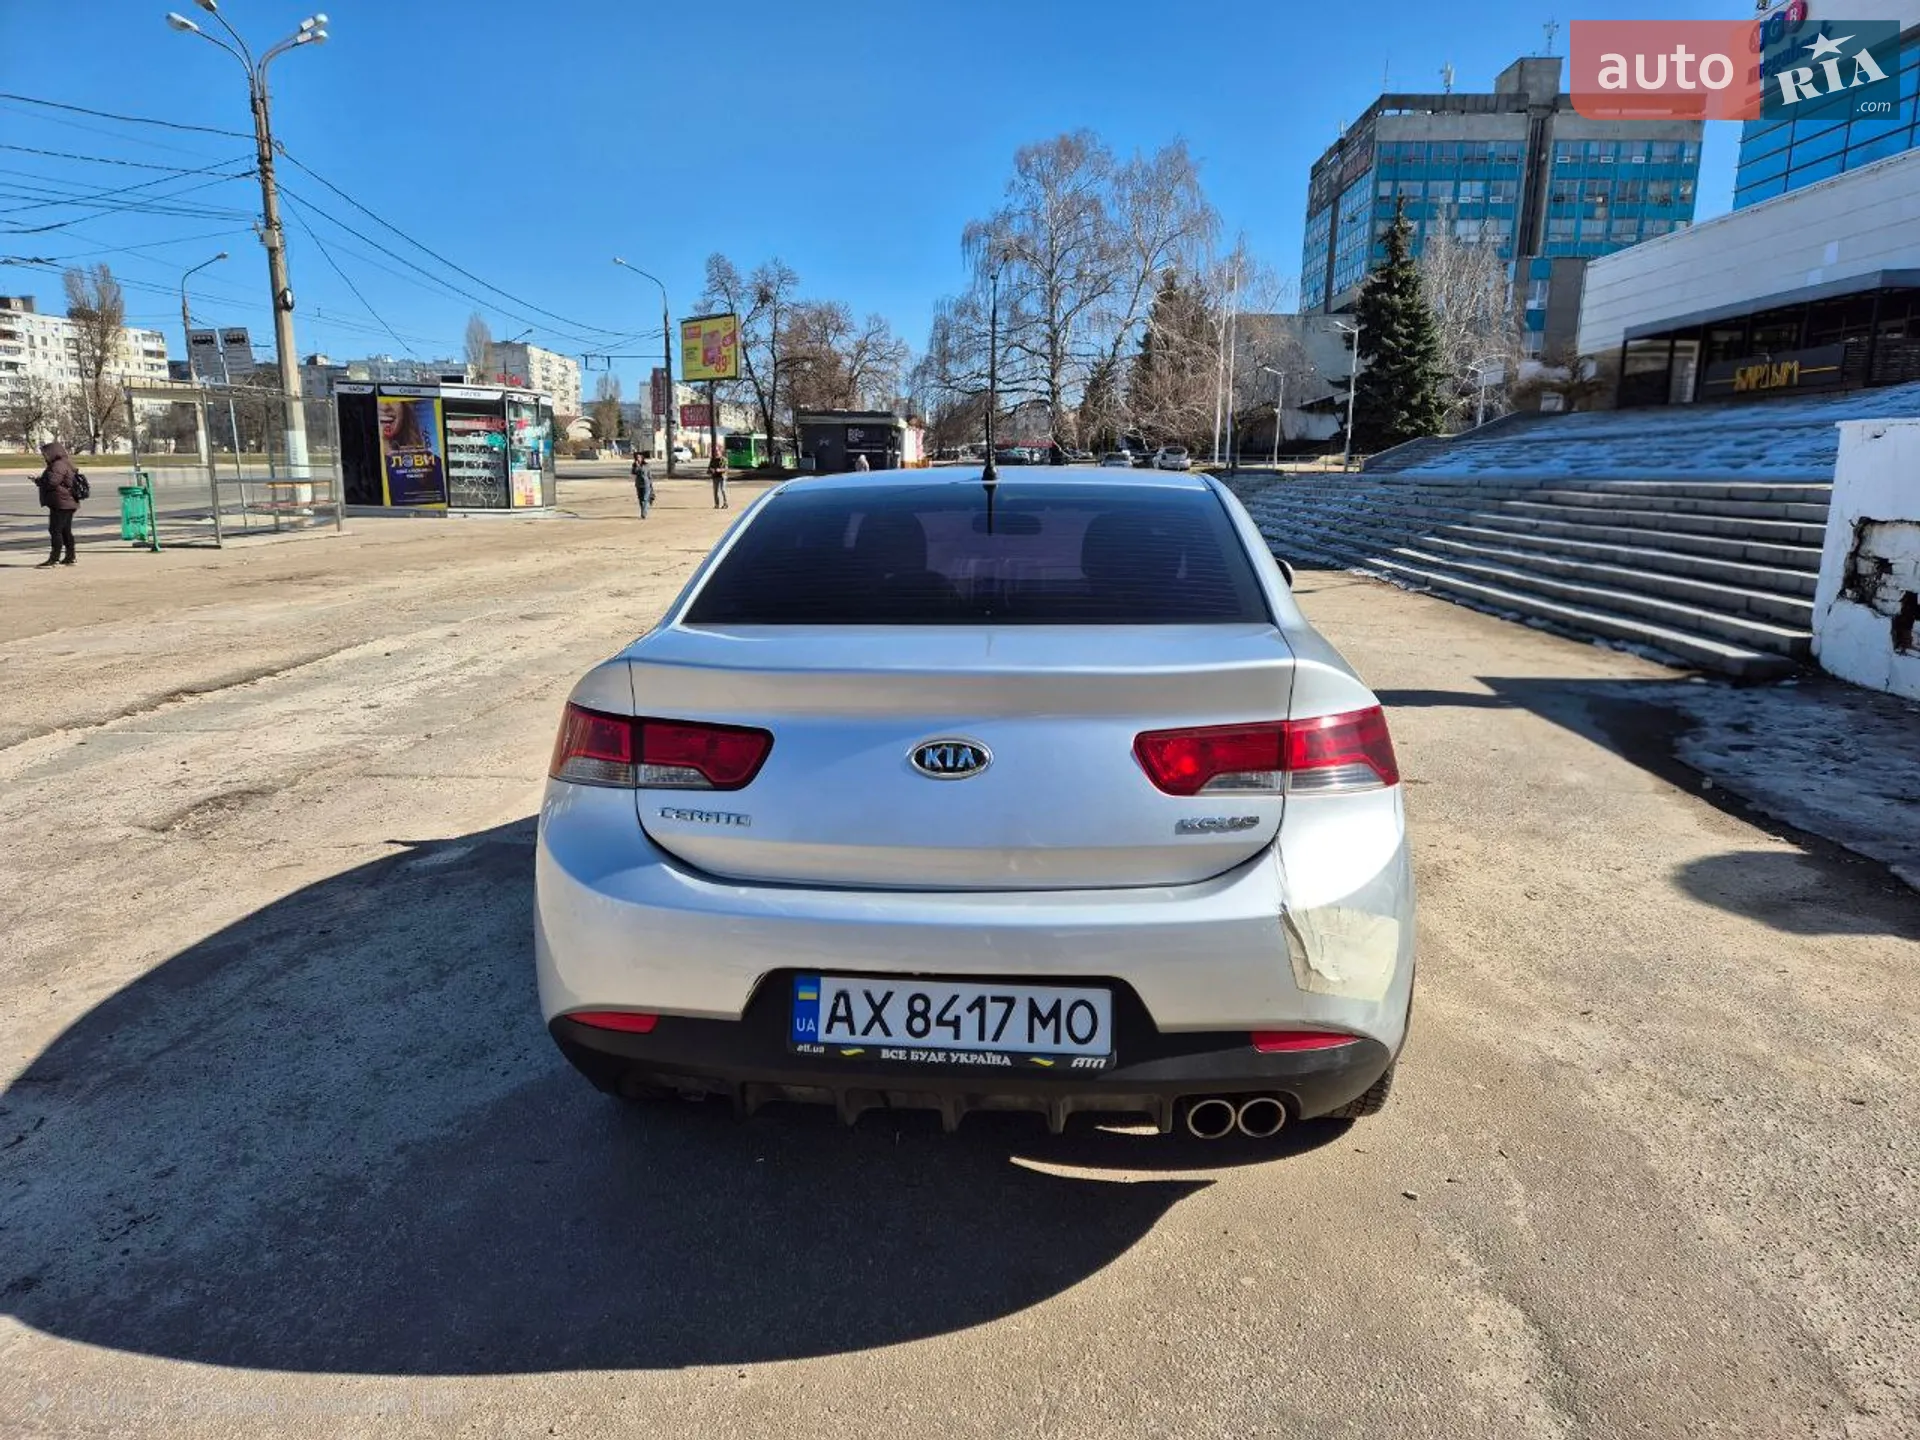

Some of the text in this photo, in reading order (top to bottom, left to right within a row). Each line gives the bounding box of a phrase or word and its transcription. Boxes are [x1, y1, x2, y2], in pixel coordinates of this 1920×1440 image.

[391, 454, 435, 468] ЛОВИ
[924, 744, 976, 770] KIA
[659, 806, 753, 828] CERATO
[796, 1017, 817, 1033] UA
[825, 989, 1099, 1046] AX 8417 MO
[880, 1049, 1013, 1067] ВСЕ БУДЕ УКРАЇНА
